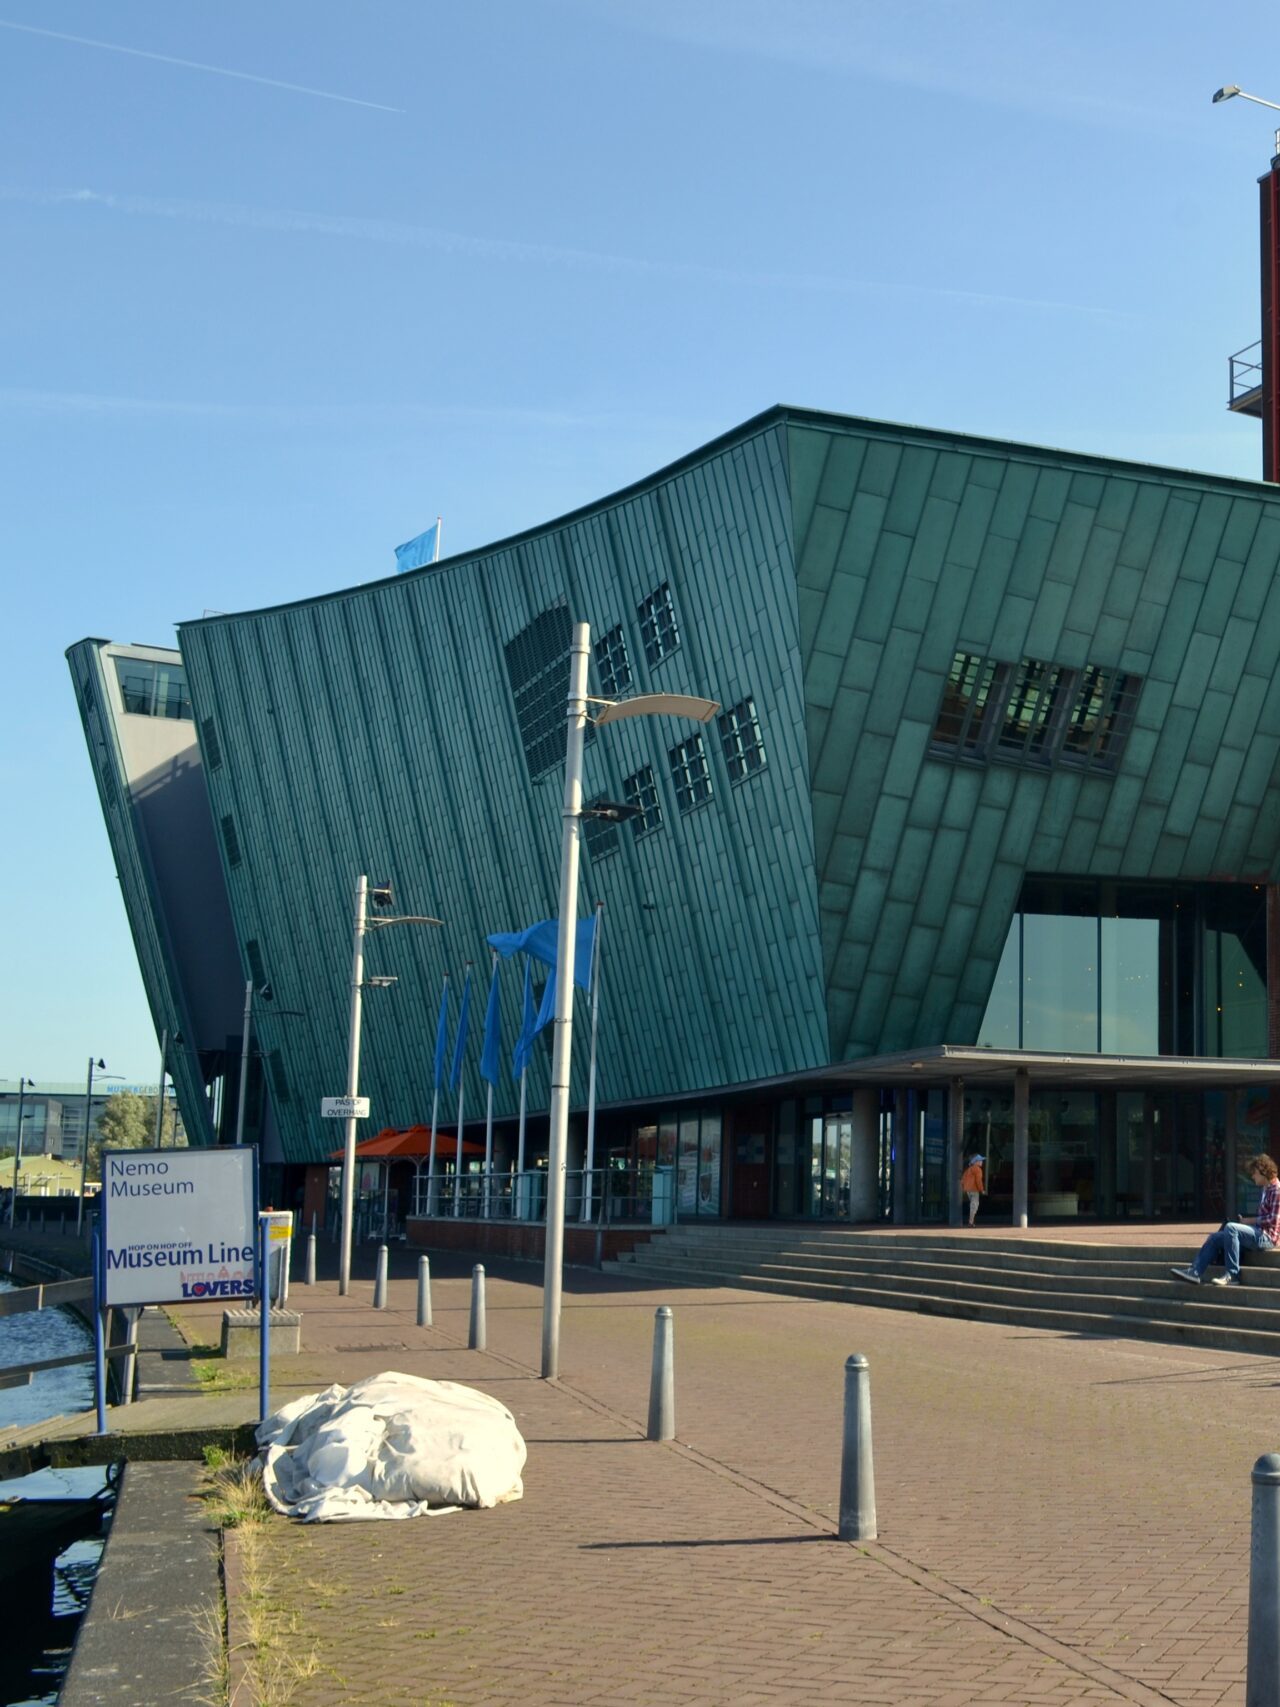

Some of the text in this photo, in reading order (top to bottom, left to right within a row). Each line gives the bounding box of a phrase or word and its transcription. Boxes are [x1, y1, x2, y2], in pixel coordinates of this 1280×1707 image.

[111, 1160, 169, 1177] Nemo
[111, 1180, 194, 1198] Museum
[107, 1242, 254, 1270] Museum Line
[181, 1279, 255, 1298] LOVERS
